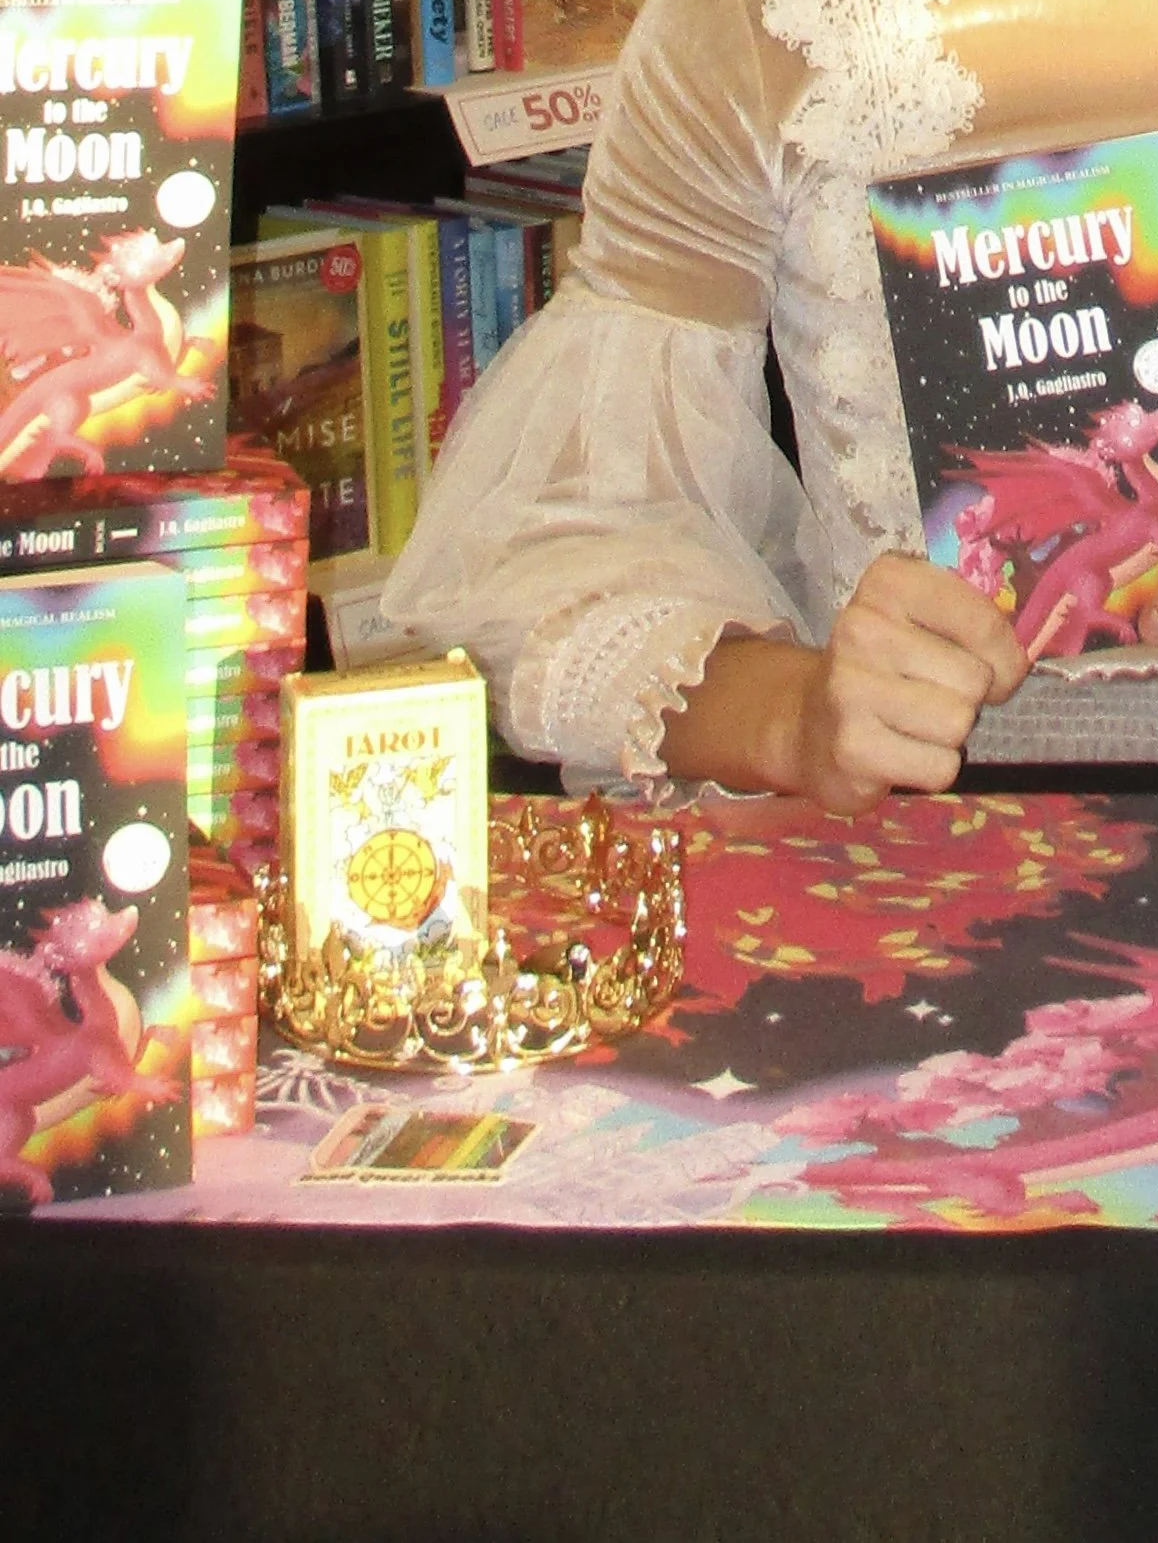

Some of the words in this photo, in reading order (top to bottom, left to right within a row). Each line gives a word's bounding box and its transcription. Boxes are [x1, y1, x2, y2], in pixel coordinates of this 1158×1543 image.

[4, 127, 141, 183] Moon
[1064, 164, 1111, 184] REALISM
[930, 203, 1135, 288] Mercury
[1007, 284, 1030, 309] to
[1034, 277, 1069, 306] the
[979, 304, 1113, 372] Moon
[1035, 369, 1107, 397] Gagliastro
[276, 413, 357, 455] MISE
[19, 528, 75, 556] Moon
[0, 659, 134, 730] cury
[344, 726, 440, 759] TAROT
